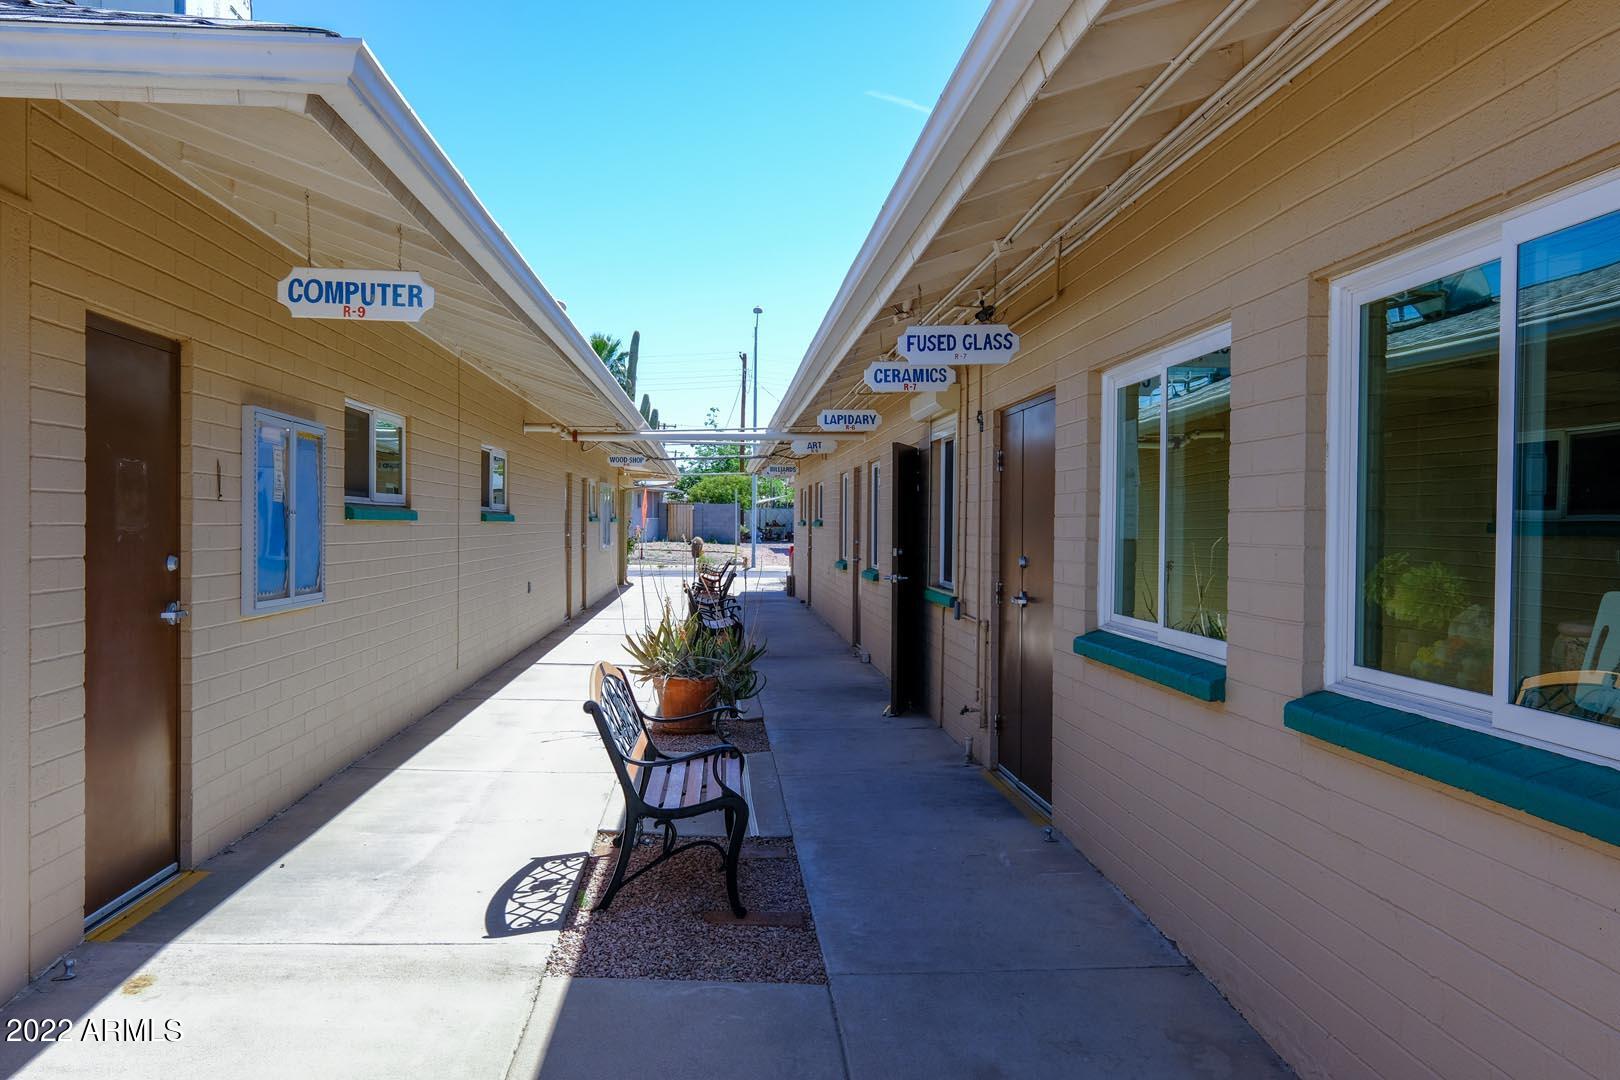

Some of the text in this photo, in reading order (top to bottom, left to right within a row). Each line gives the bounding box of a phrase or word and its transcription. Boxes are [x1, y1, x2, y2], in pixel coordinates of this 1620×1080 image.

[287, 278, 423, 308] COMPUTER
[343, 305, 366, 318] R-9
[906, 333, 1013, 352] FUSED GLASS
[873, 368, 947, 383] CERAMICS
[903, 383, 917, 391] R-7
[824, 414, 877, 425] LAPIDARY
[806, 441, 823, 450] ART
